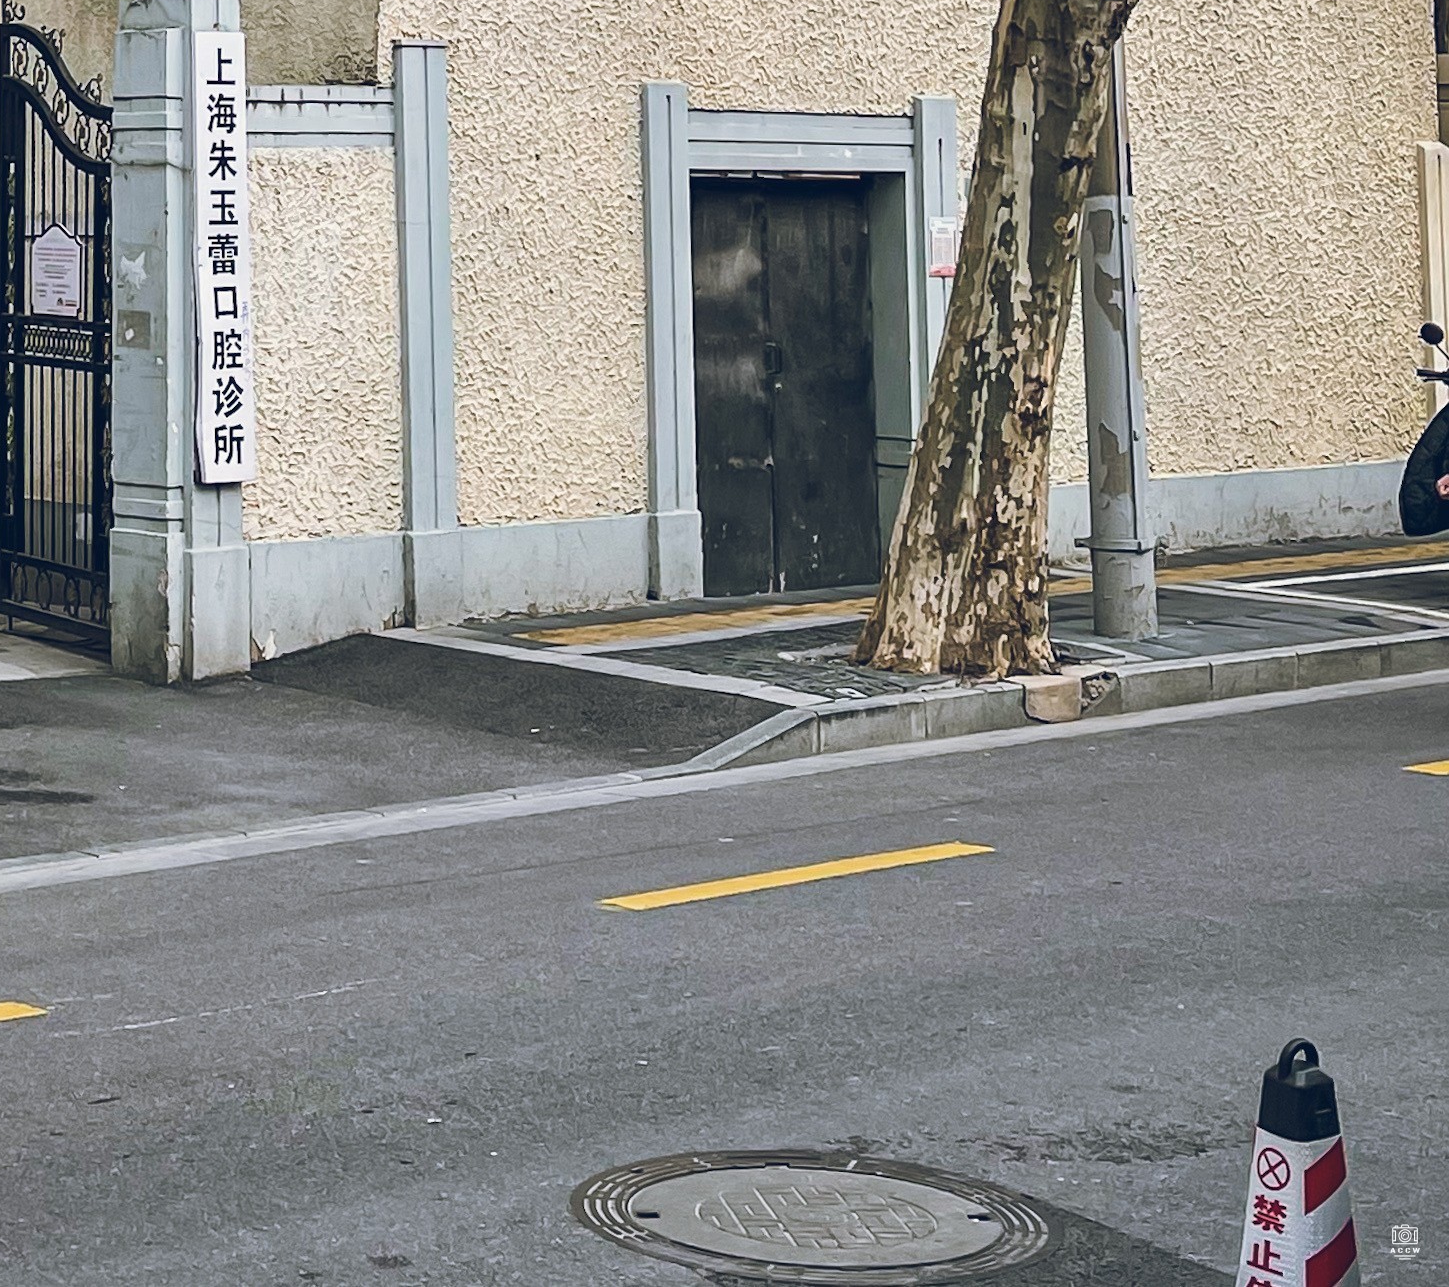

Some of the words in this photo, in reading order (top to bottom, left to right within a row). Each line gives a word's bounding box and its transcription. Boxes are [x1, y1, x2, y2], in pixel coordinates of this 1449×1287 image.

[206, 47, 245, 465] 上海朱玉蕾口腔诊所
[1245, 1194, 1287, 1287] 禁止
